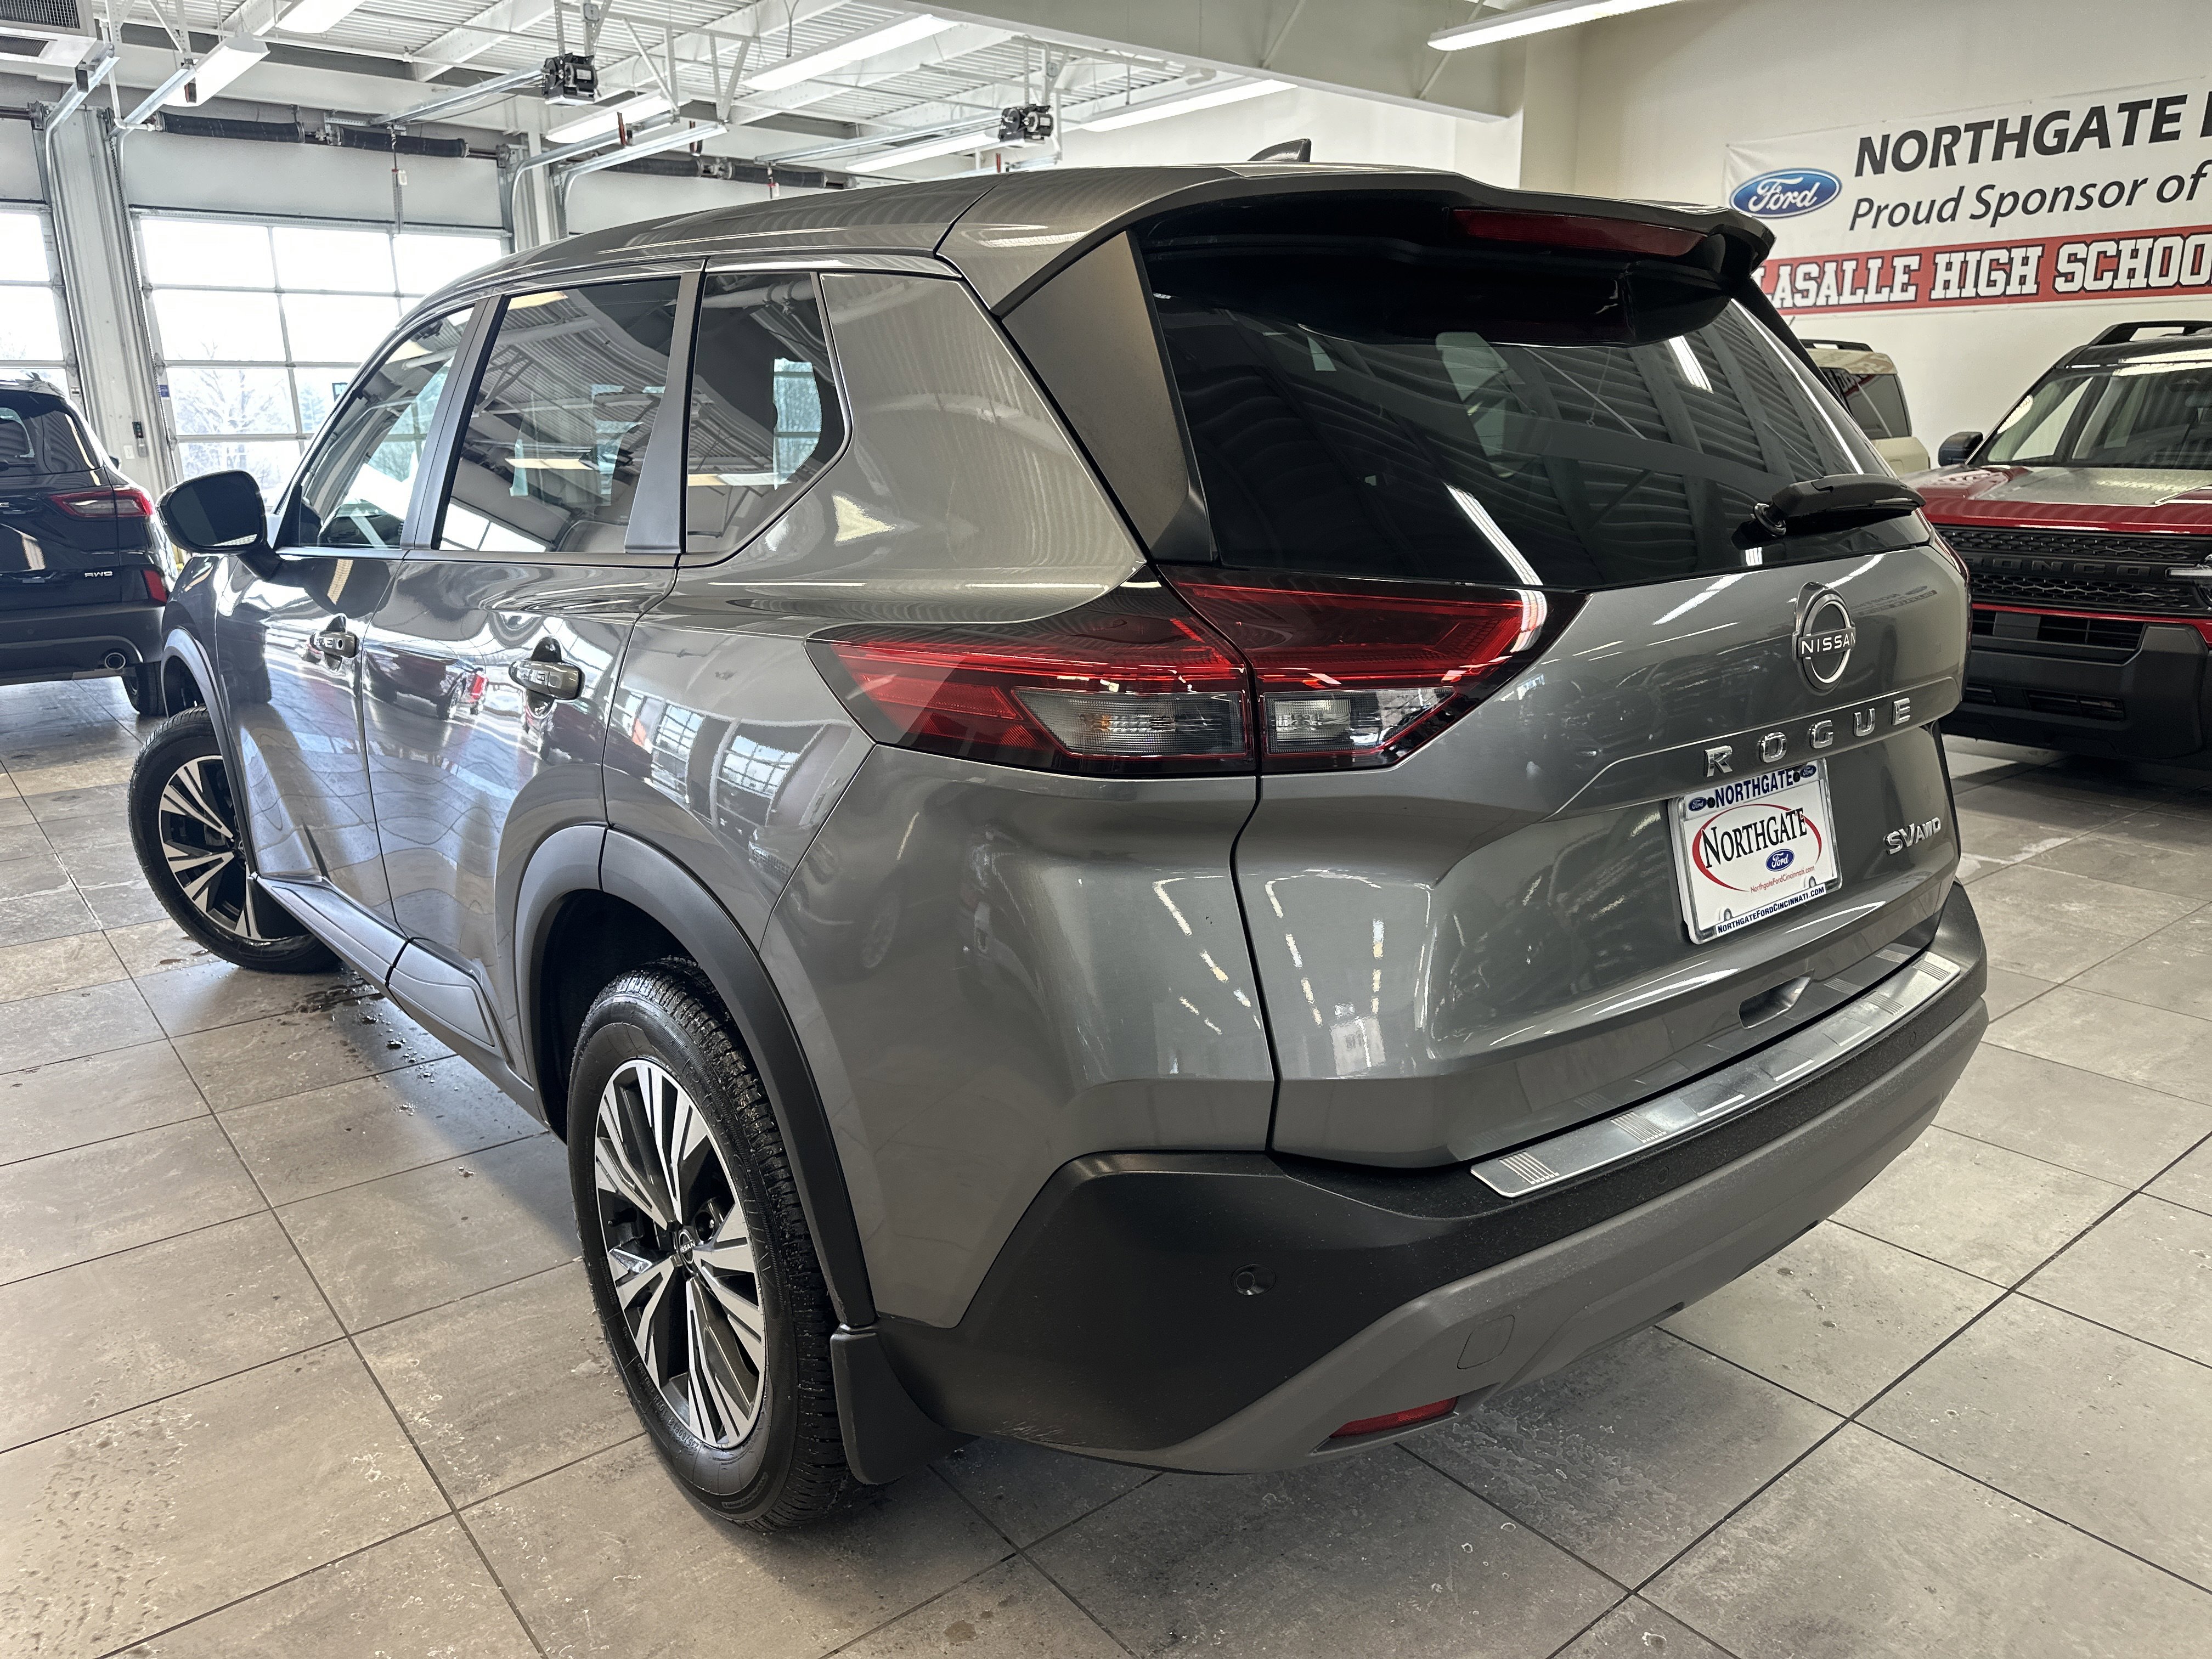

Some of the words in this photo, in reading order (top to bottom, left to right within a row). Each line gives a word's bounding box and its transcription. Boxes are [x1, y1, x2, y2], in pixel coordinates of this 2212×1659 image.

[1855, 94, 2188, 177] NORTHGATE
[1849, 186, 1965, 231] Proud
[1969, 177, 2148, 228] Sponsor
[2156, 159, 2212, 204] of
[1929, 243, 2046, 301] HIGH
[2053, 233, 2212, 295] SCHOO
[1963, 556, 2151, 576] RONCO
[1801, 631, 1856, 654] NISSAN
[1704, 697, 1911, 777] ROGUE
[1715, 770, 1793, 808] NORTHGATE
[1702, 807, 1808, 868] NORTHGATE
[1885, 823, 1915, 855] SV
[1915, 817, 1942, 844] AWD
[1750, 866, 1815, 893] NorthgateFordCincinnati.com
[680, 1241, 696, 1253] SSAN
